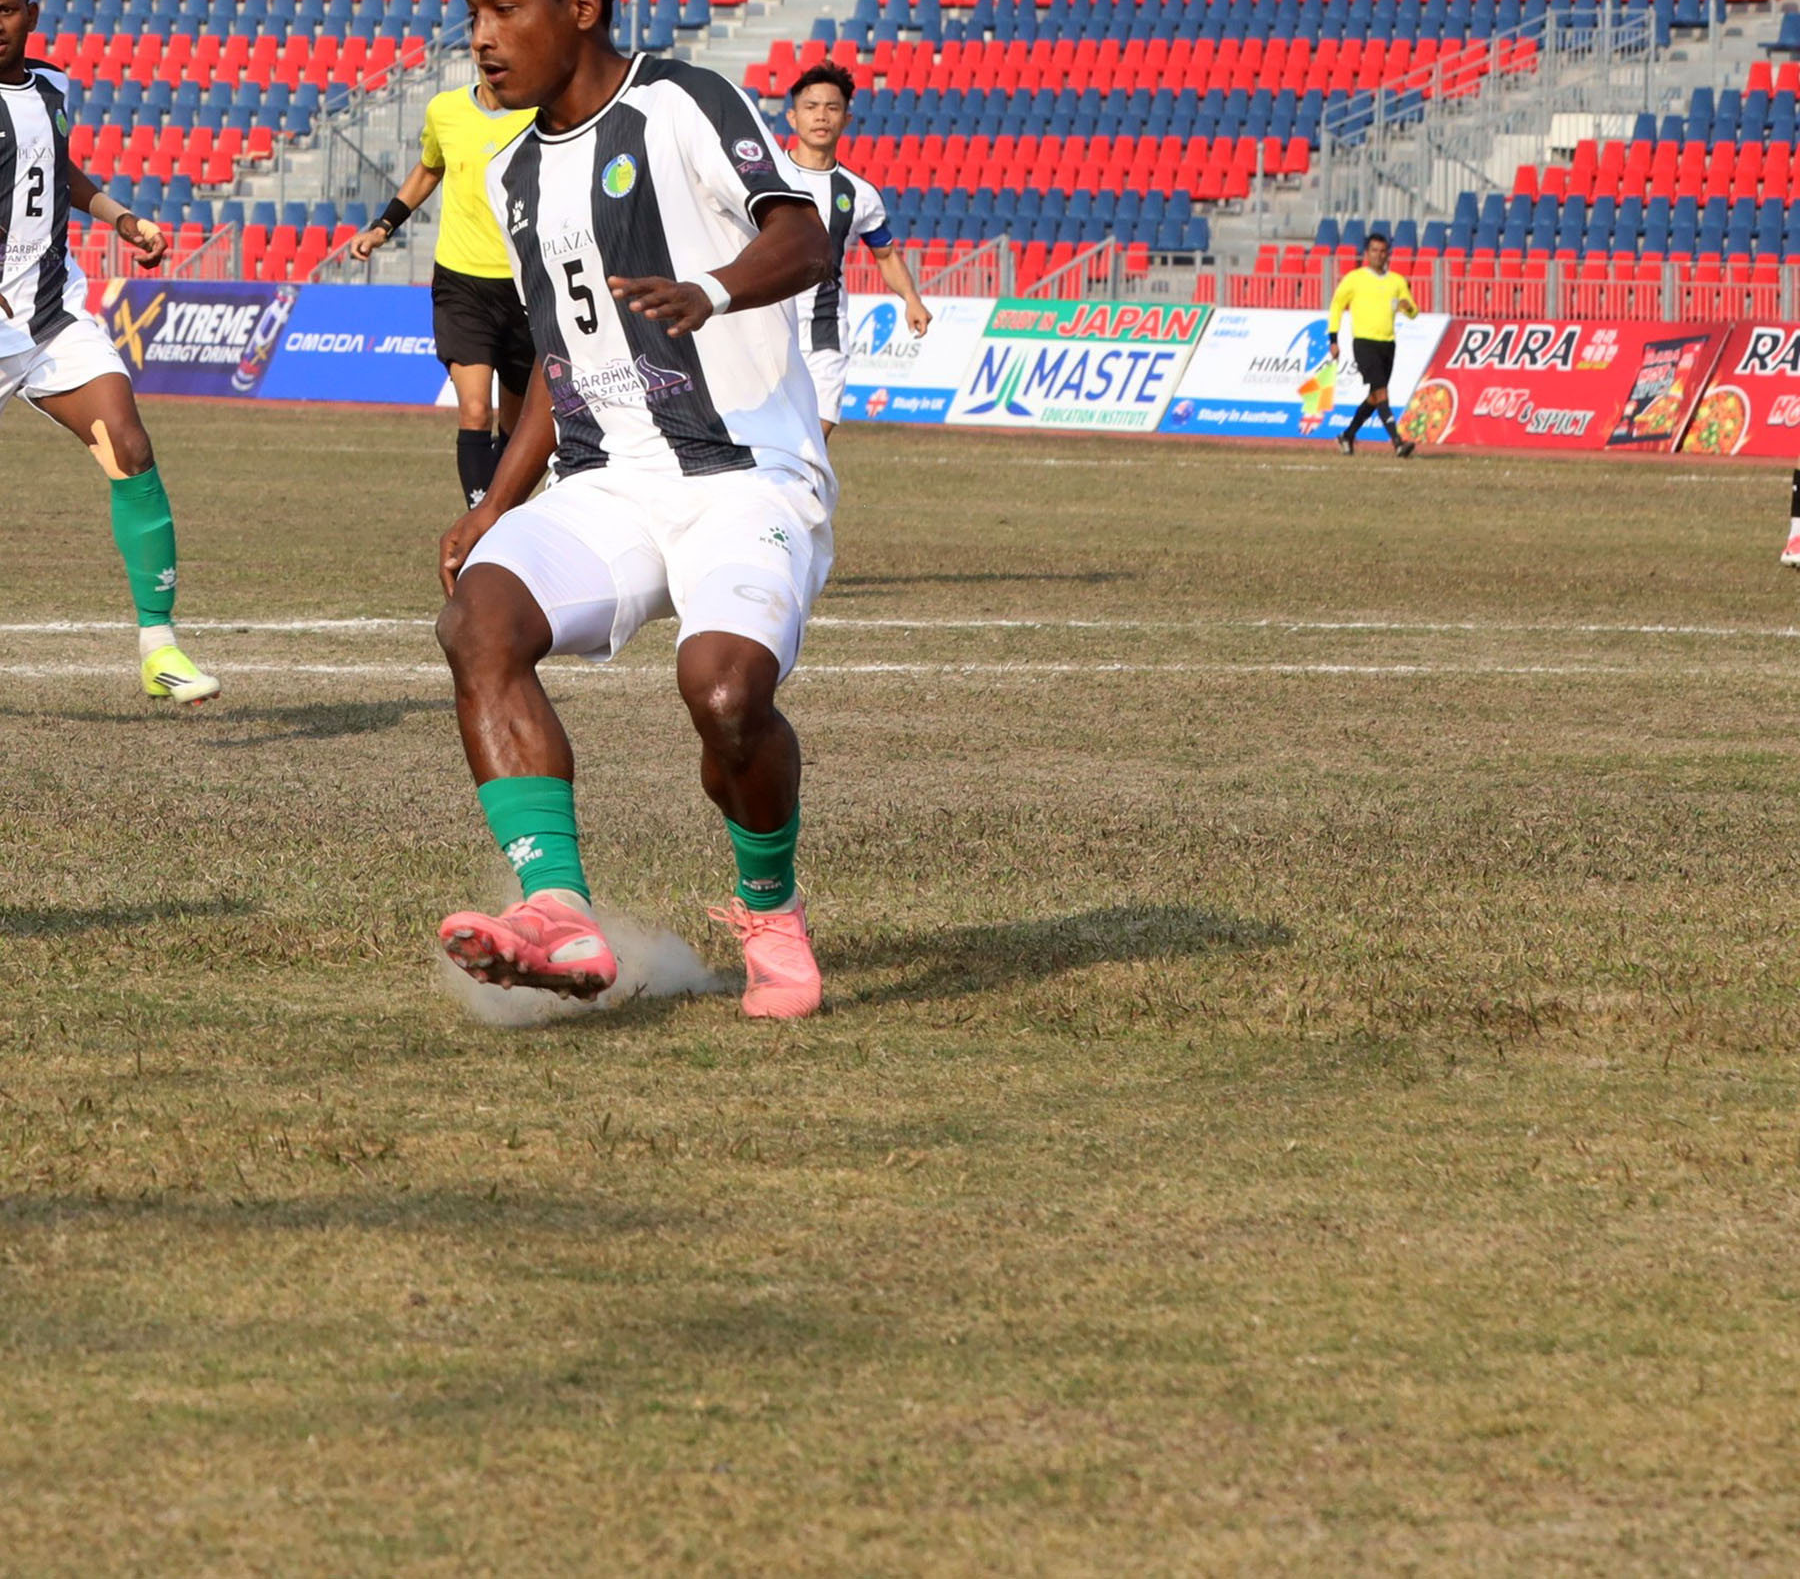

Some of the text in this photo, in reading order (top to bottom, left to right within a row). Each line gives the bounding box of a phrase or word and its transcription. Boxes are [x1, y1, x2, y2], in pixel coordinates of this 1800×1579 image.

[18, 147, 54, 159] PLAZA
[26, 167, 44, 217] 2
[542, 228, 593, 259] PLAZA
[563, 259, 598, 335] 5
[154, 302, 260, 346] XTREME
[991, 310, 1038, 330] STUDY
[1041, 312, 1058, 331] IN
[1058, 305, 1201, 340] JAPAN
[145, 343, 244, 363] ENERGY DRINK
[285, 333, 437, 355] OMODA JAEC
[1446, 324, 1581, 370] RARA
[1734, 326, 1800, 376] RA
[601, 381, 641, 397] SEWA
[892, 397, 918, 412] Study
[931, 398, 946, 411] UK
[1040, 407, 1150, 427] EDUCATION INSTITUTE
[1197, 409, 1228, 423] Study
[1238, 410, 1289, 424] Australia
[1473, 387, 1530, 417] HOT
[1526, 410, 1594, 436] SPICY
[1767, 395, 1800, 427] HO
